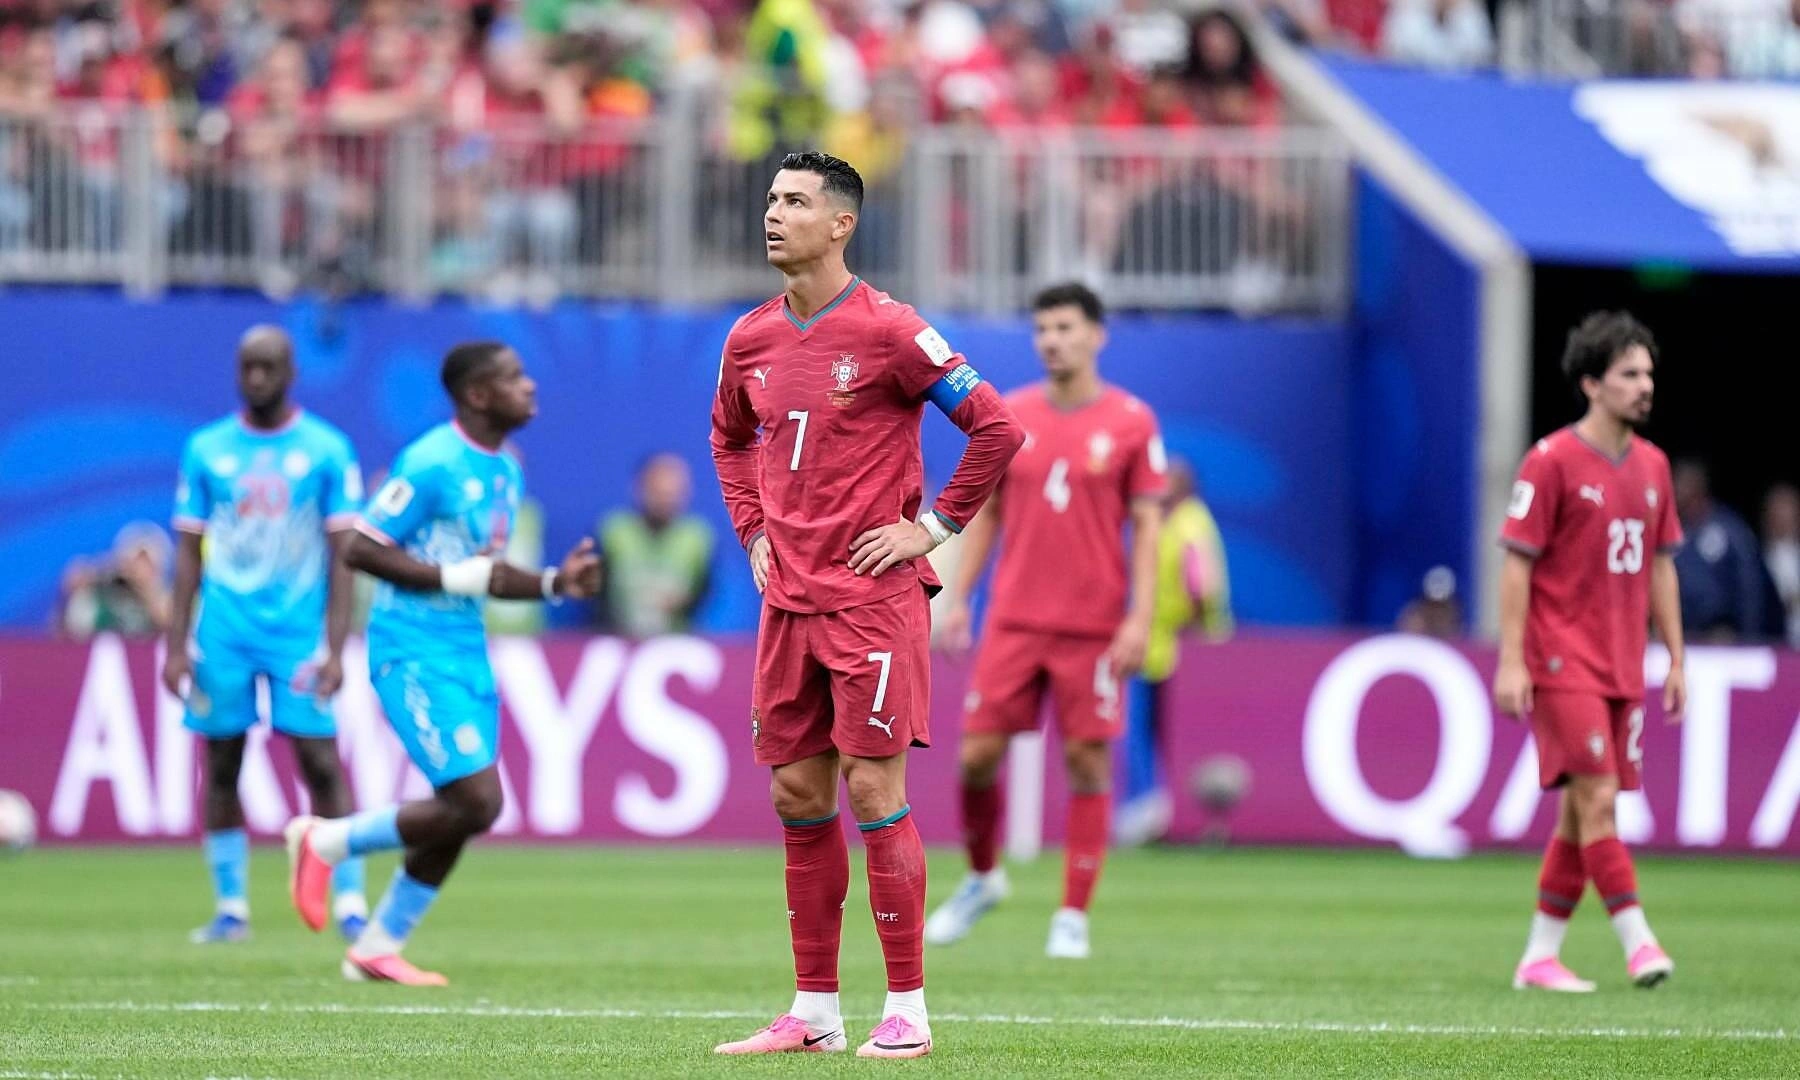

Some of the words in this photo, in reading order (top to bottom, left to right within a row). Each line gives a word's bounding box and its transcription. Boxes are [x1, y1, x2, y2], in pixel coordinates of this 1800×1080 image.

[788, 410, 809, 471] 7
[1043, 458, 1072, 514] 4
[1607, 518, 1645, 573] 23
[868, 651, 893, 713] 7
